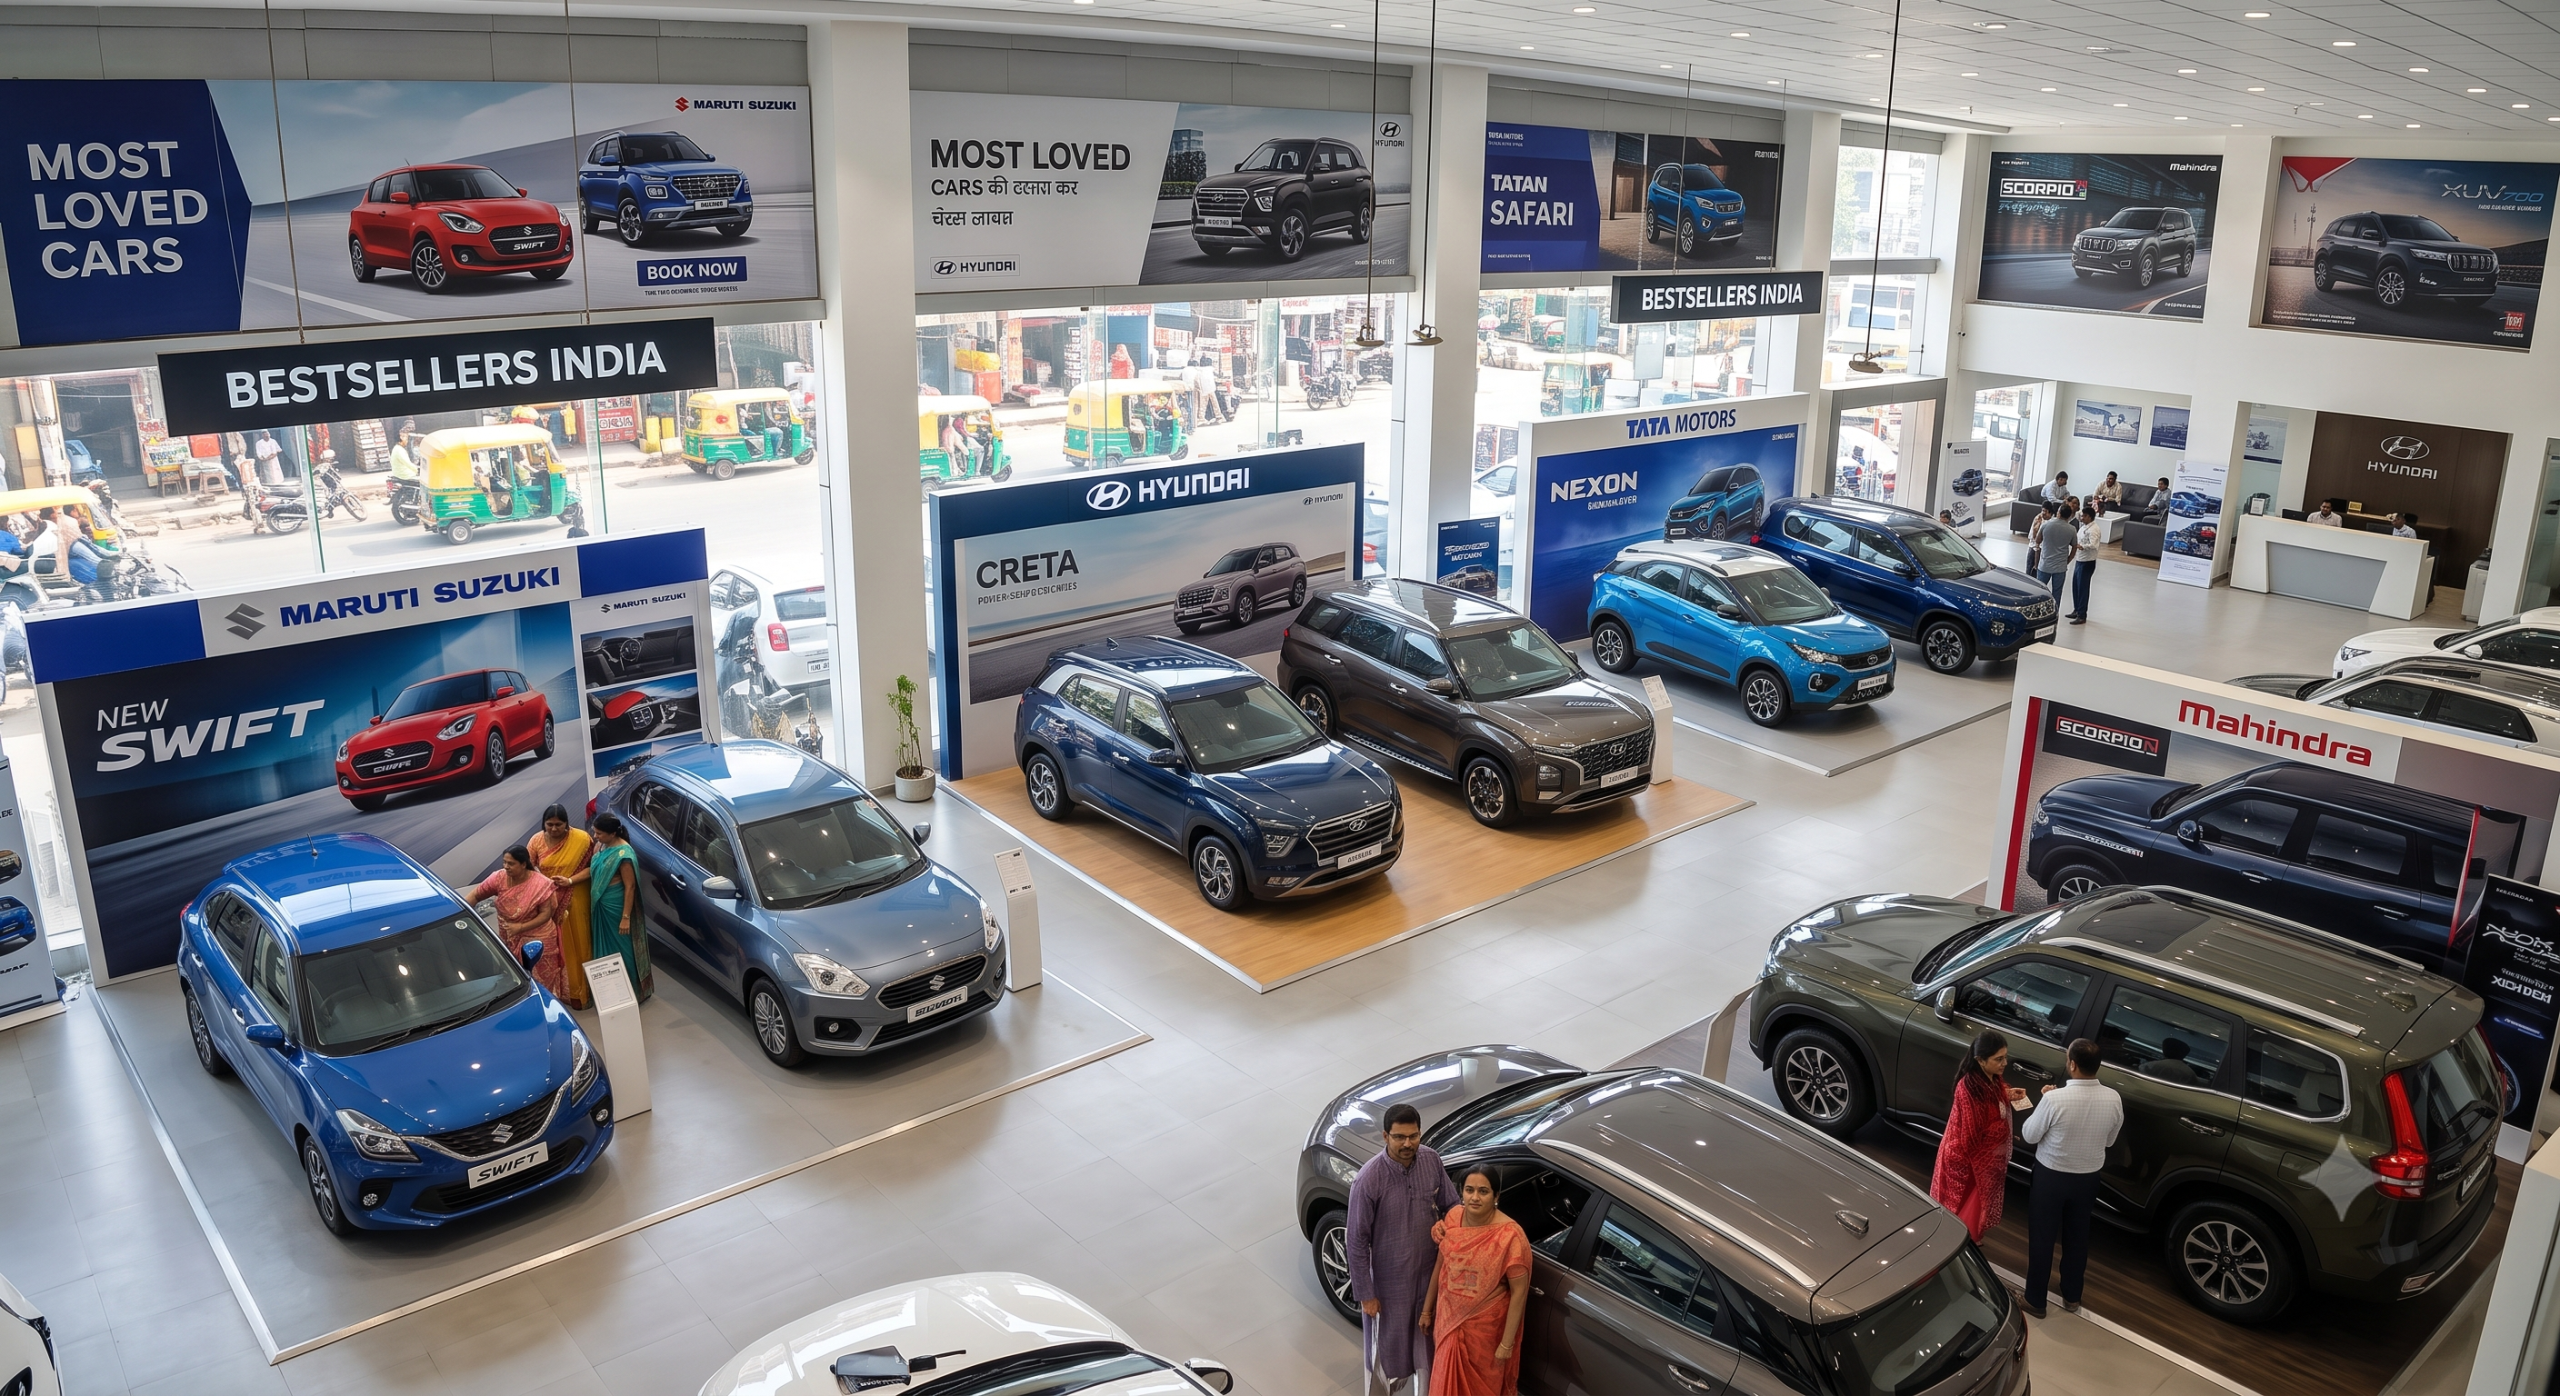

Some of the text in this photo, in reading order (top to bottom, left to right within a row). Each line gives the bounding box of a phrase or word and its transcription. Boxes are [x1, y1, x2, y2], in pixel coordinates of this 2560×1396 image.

[694, 99, 797, 111] MARUTI SUZUKI
[27, 141, 179, 181] MOST
[930, 139, 1131, 171] MOST LOVED
[931, 178, 984, 196] CARS
[987, 175, 1009, 195] की
[1054, 181, 1079, 196] कर
[1490, 174, 1548, 193] TATAN
[34, 189, 208, 231] LOVED
[1489, 199, 1575, 226] SAFARI
[41, 236, 184, 279] CARS
[513, 241, 546, 251] SWIFT
[646, 262, 738, 280] BOOK NOW
[960, 260, 1016, 273] HYUNDAI
[1641, 283, 1804, 311] BESTSELLERS INDIA
[225, 340, 667, 409] BESTSELLERS INDIA
[1626, 408, 1736, 439] TATA MOTORS
[1138, 467, 1250, 503] HYUNDAI
[2367, 460, 2438, 480] HYUNDAI
[1550, 470, 1638, 503] NEXON
[976, 549, 1080, 589] CRETA
[280, 566, 561, 628] MARUTI SUZUKI
[613, 592, 687, 610] MARUTI SUZUKI
[97, 698, 169, 732] NEW
[96, 699, 326, 772] SWIFT
[476, 1150, 539, 1183] SWIFT
